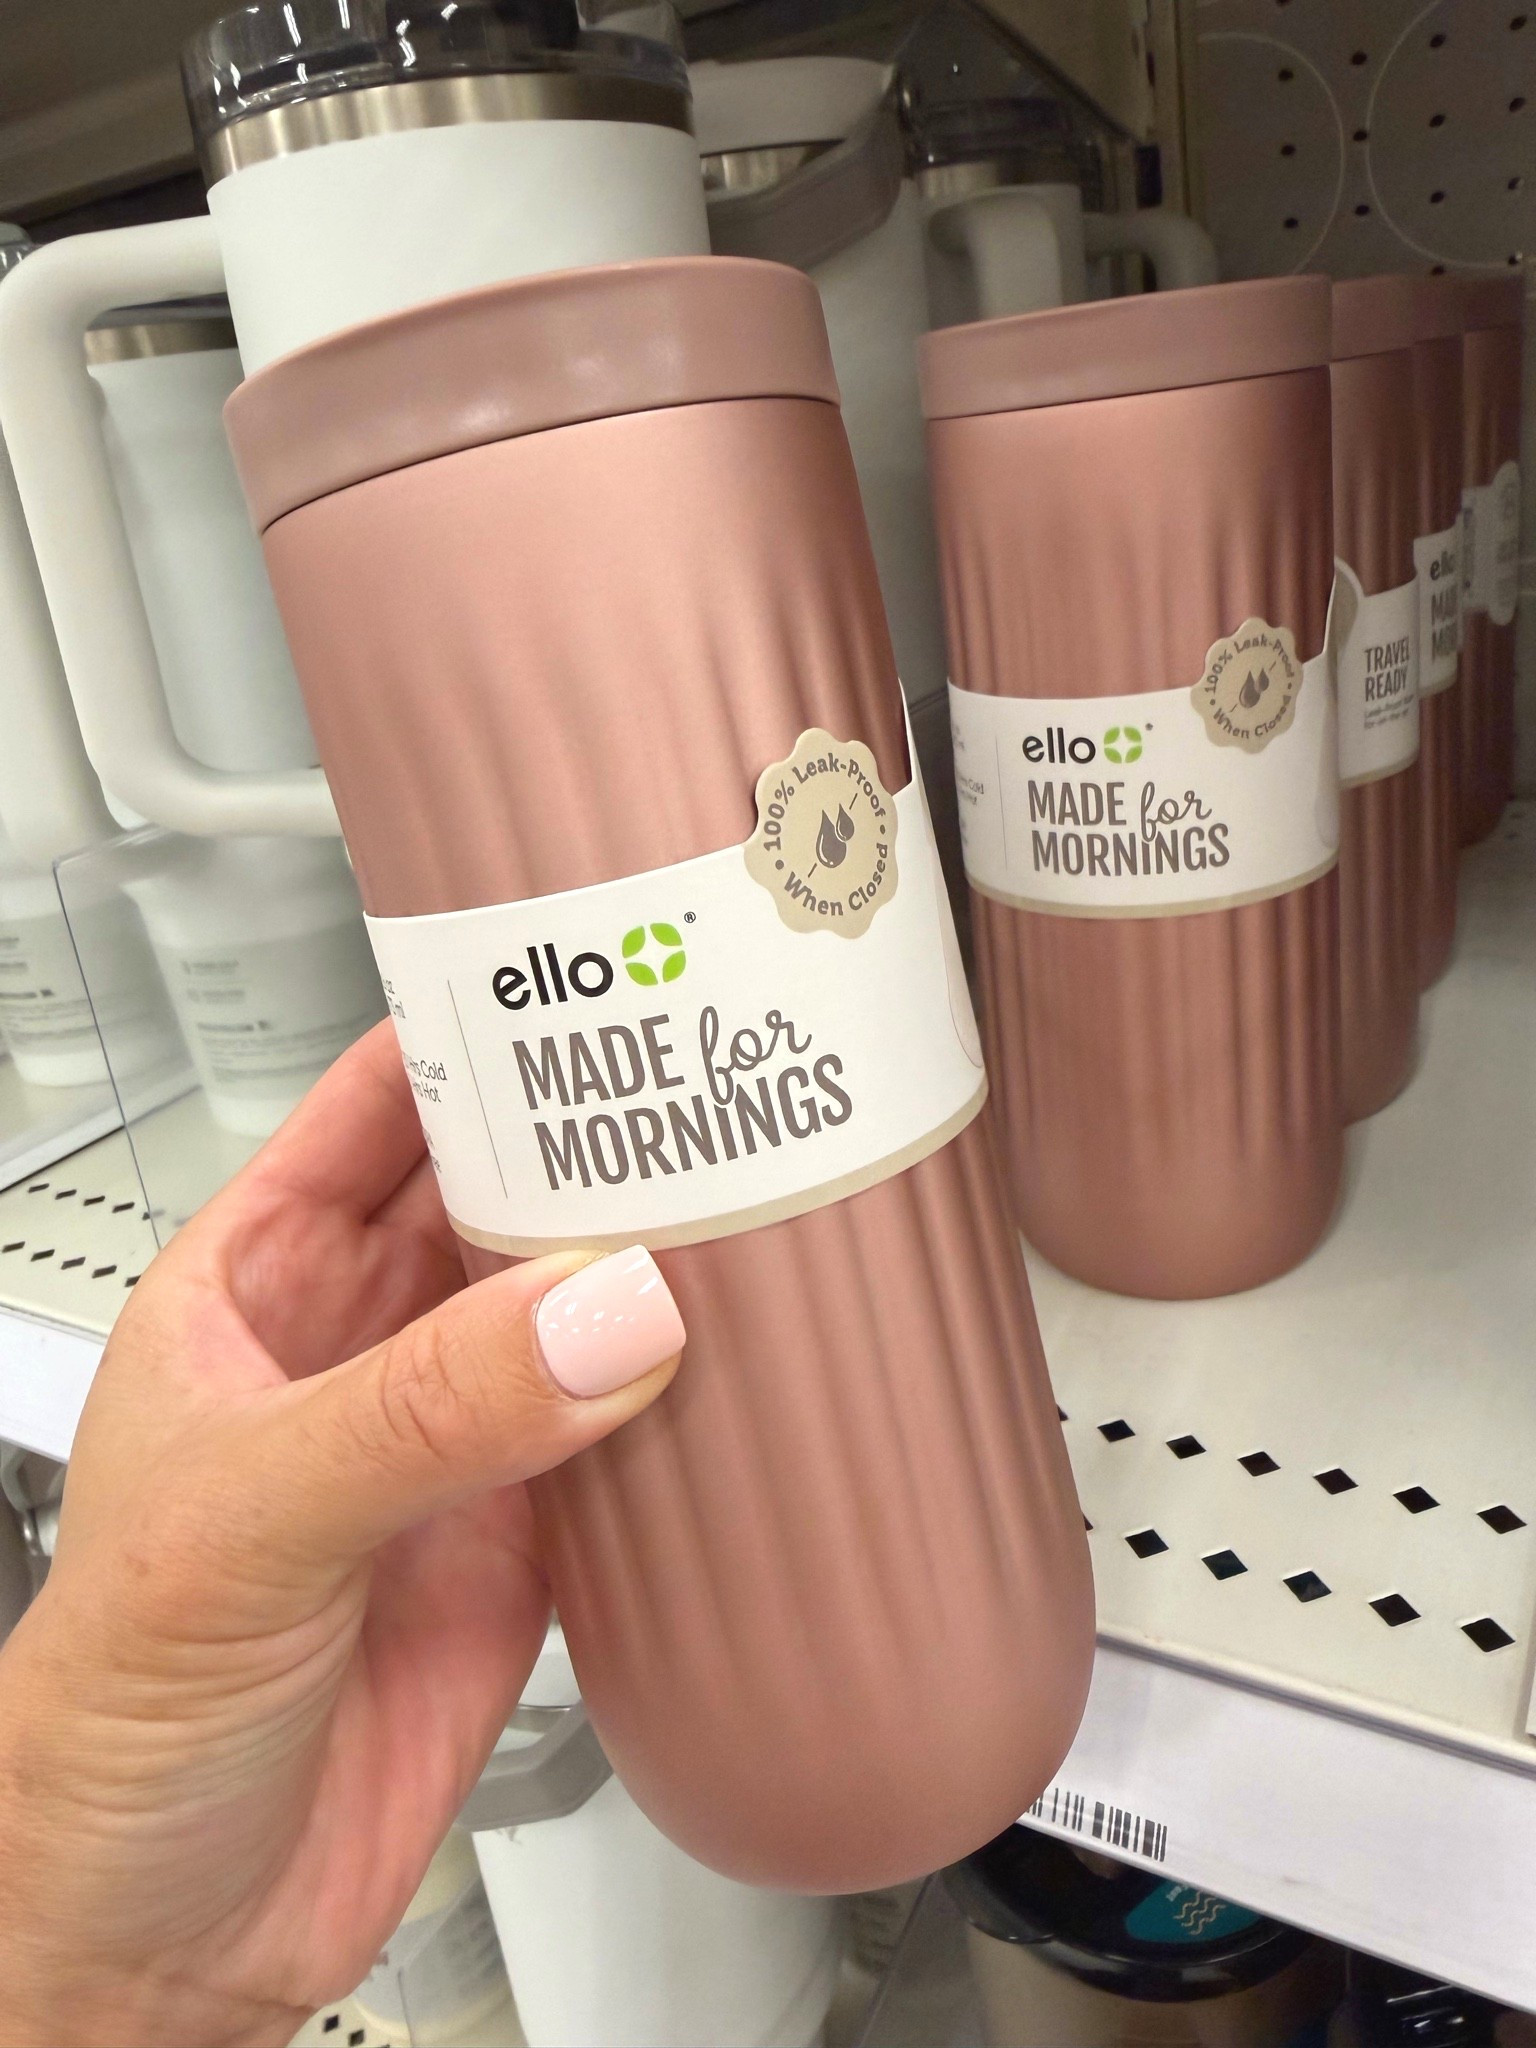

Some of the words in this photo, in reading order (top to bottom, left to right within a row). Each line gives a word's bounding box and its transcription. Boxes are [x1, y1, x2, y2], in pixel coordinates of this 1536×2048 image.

[1205, 649, 1233, 693] 100%
[1364, 664, 1408, 702] READY
[1022, 727, 1096, 764] ello
[1213, 708, 1249, 739] When
[764, 780, 795, 851] 100%
[792, 752, 886, 818] Leak-Proof
[1028, 780, 1127, 826] MADE
[1140, 781, 1213, 842] for
[1031, 823, 1230, 877] MORNINGS
[784, 871, 844, 916] When
[848, 843, 888, 911] Closed
[492, 943, 614, 1010] ello
[420, 1060, 447, 1081] Cold
[512, 1014, 685, 1110] MADE
[700, 1005, 812, 1106] for
[421, 1081, 442, 1103] Hot
[534, 1054, 853, 1190] MORNINGS
